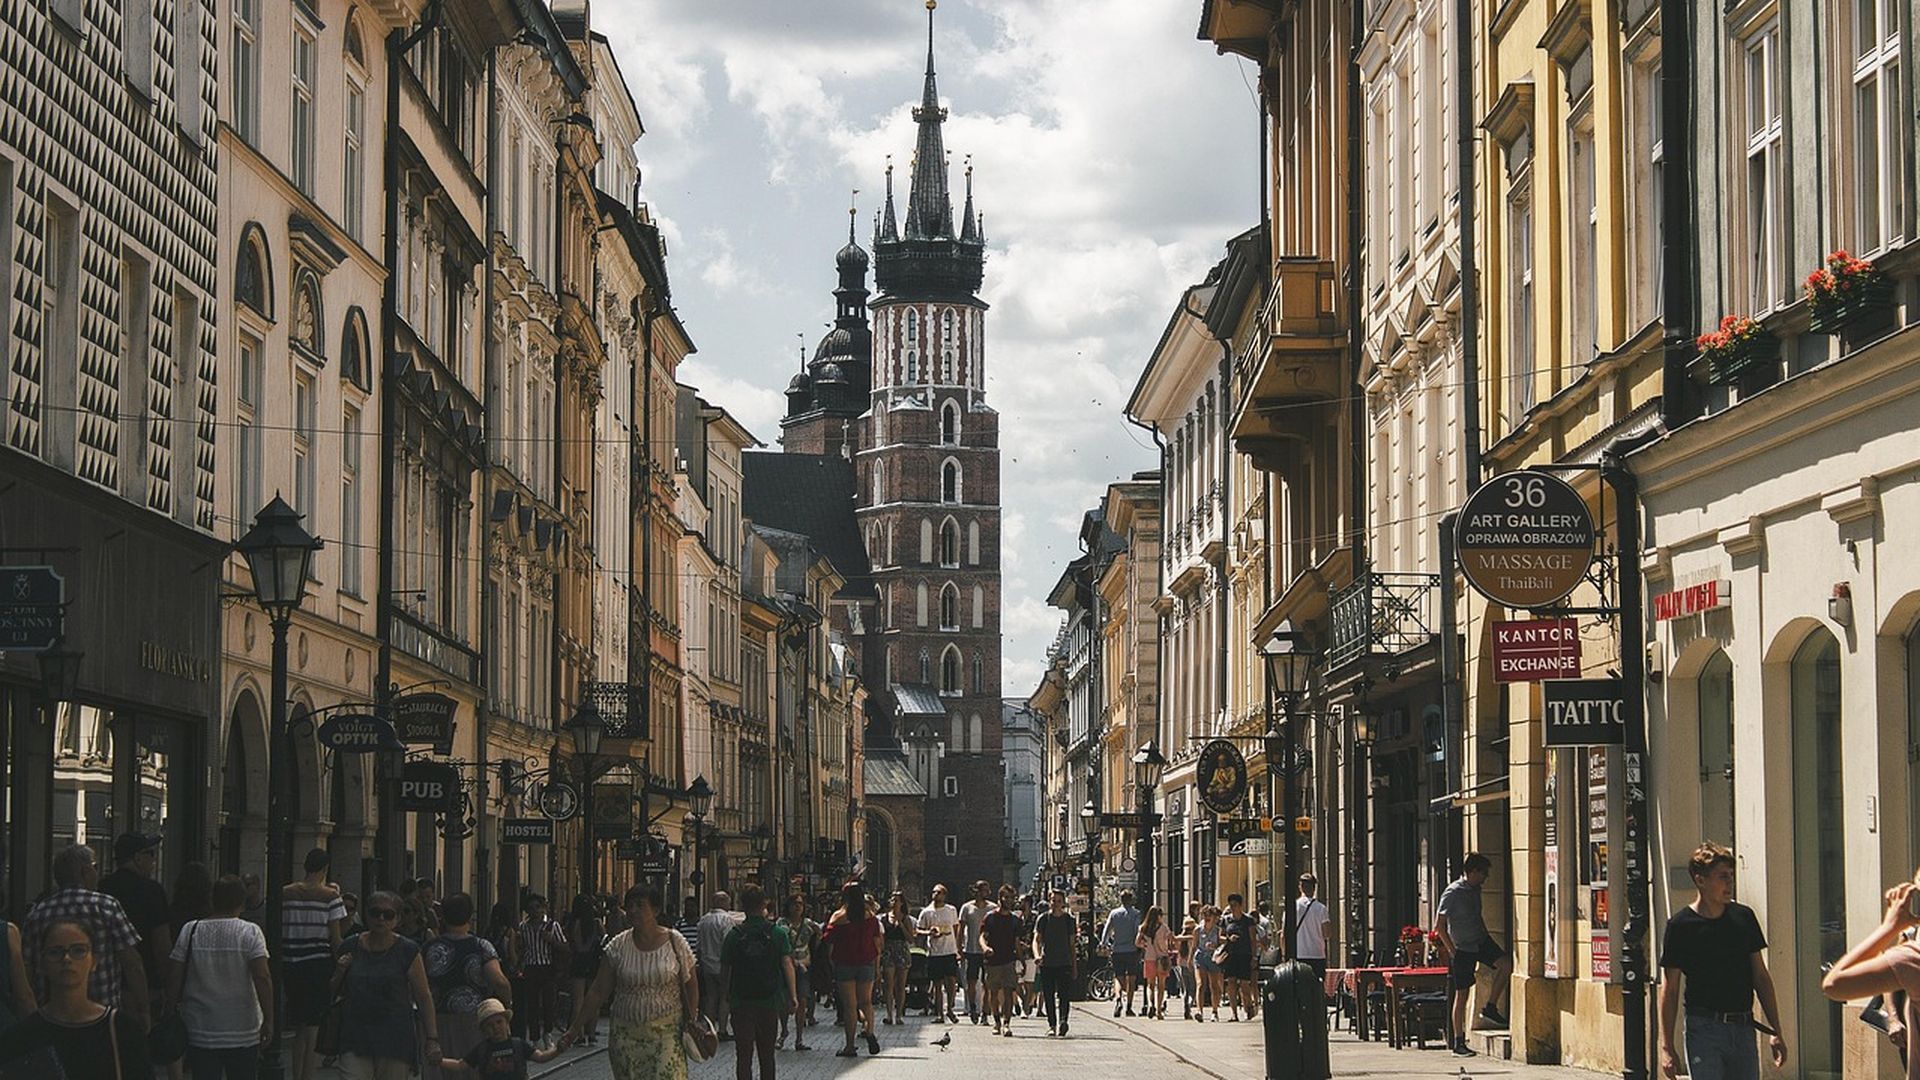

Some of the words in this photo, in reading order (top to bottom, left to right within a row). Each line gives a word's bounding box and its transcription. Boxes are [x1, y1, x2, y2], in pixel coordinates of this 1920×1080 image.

[1505, 478, 1545, 507] 36
[1470, 514, 1502, 527] ART
[1507, 514, 1581, 527] GALLERY
[1466, 533, 1519, 543] OPRAWA
[1523, 531, 1585, 543] OBRAZÓW
[1480, 554, 1572, 569] MASSAGE
[1499, 576, 1553, 589] ThaiBali
[1499, 627, 1574, 643] KANTOR
[1500, 656, 1576, 672] EXCHANGE
[332, 733, 379, 745] OPTYK
[401, 781, 443, 798] PUB
[1112, 815, 1143, 824] HOTEL
[505, 825, 551, 837] HOSTEL
